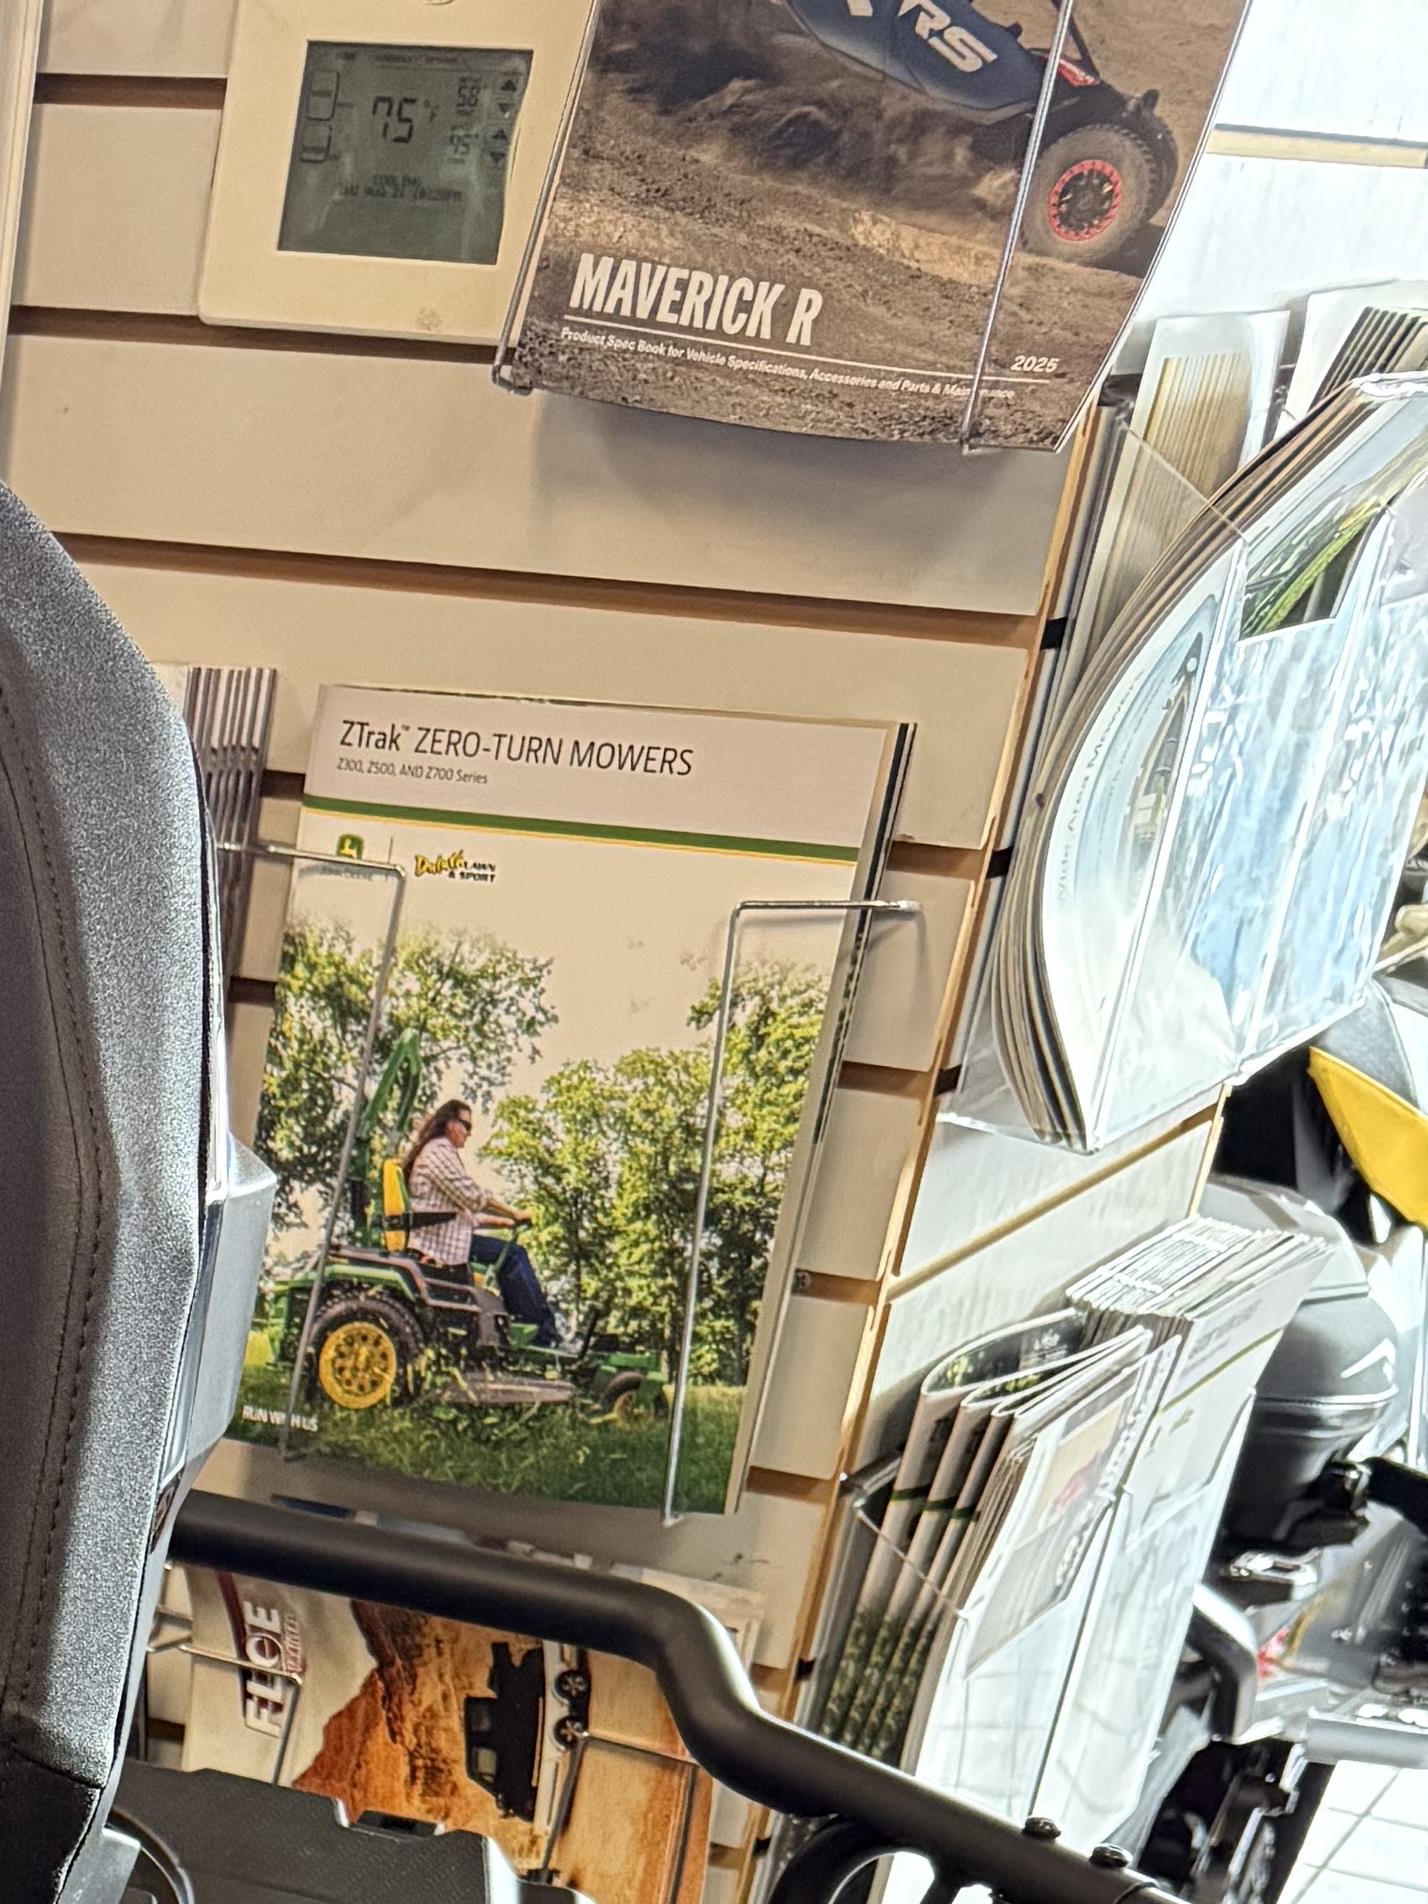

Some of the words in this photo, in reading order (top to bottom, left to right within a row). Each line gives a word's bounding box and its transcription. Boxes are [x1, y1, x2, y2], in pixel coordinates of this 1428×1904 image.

[569, 253, 786, 340] MAVERICK
[785, 288, 824, 347] R
[561, 326, 606, 346] Product
[605, 334, 637, 352] Spec
[637, 340, 666, 357] Book
[667, 345, 685, 359] for
[686, 347, 727, 368] Vehicle
[727, 354, 808, 381] Specifications,
[810, 367, 878, 388] Accessories
[878, 376, 900, 391] and
[902, 379, 930, 395] Parts
[931, 383, 941, 395] &
[1010, 355, 1060, 373] 2025
[399, 763, 424, 778] AND
[425, 766, 454, 781] Z700
[455, 769, 488, 785] Series
[414, 726, 563, 767] ZERO-TURN
[569, 740, 694, 777] MOWERS
[242, 1404, 268, 1423] RUN
[301, 1412, 318, 1432] US
[242, 1599, 284, 1738] FLOE
